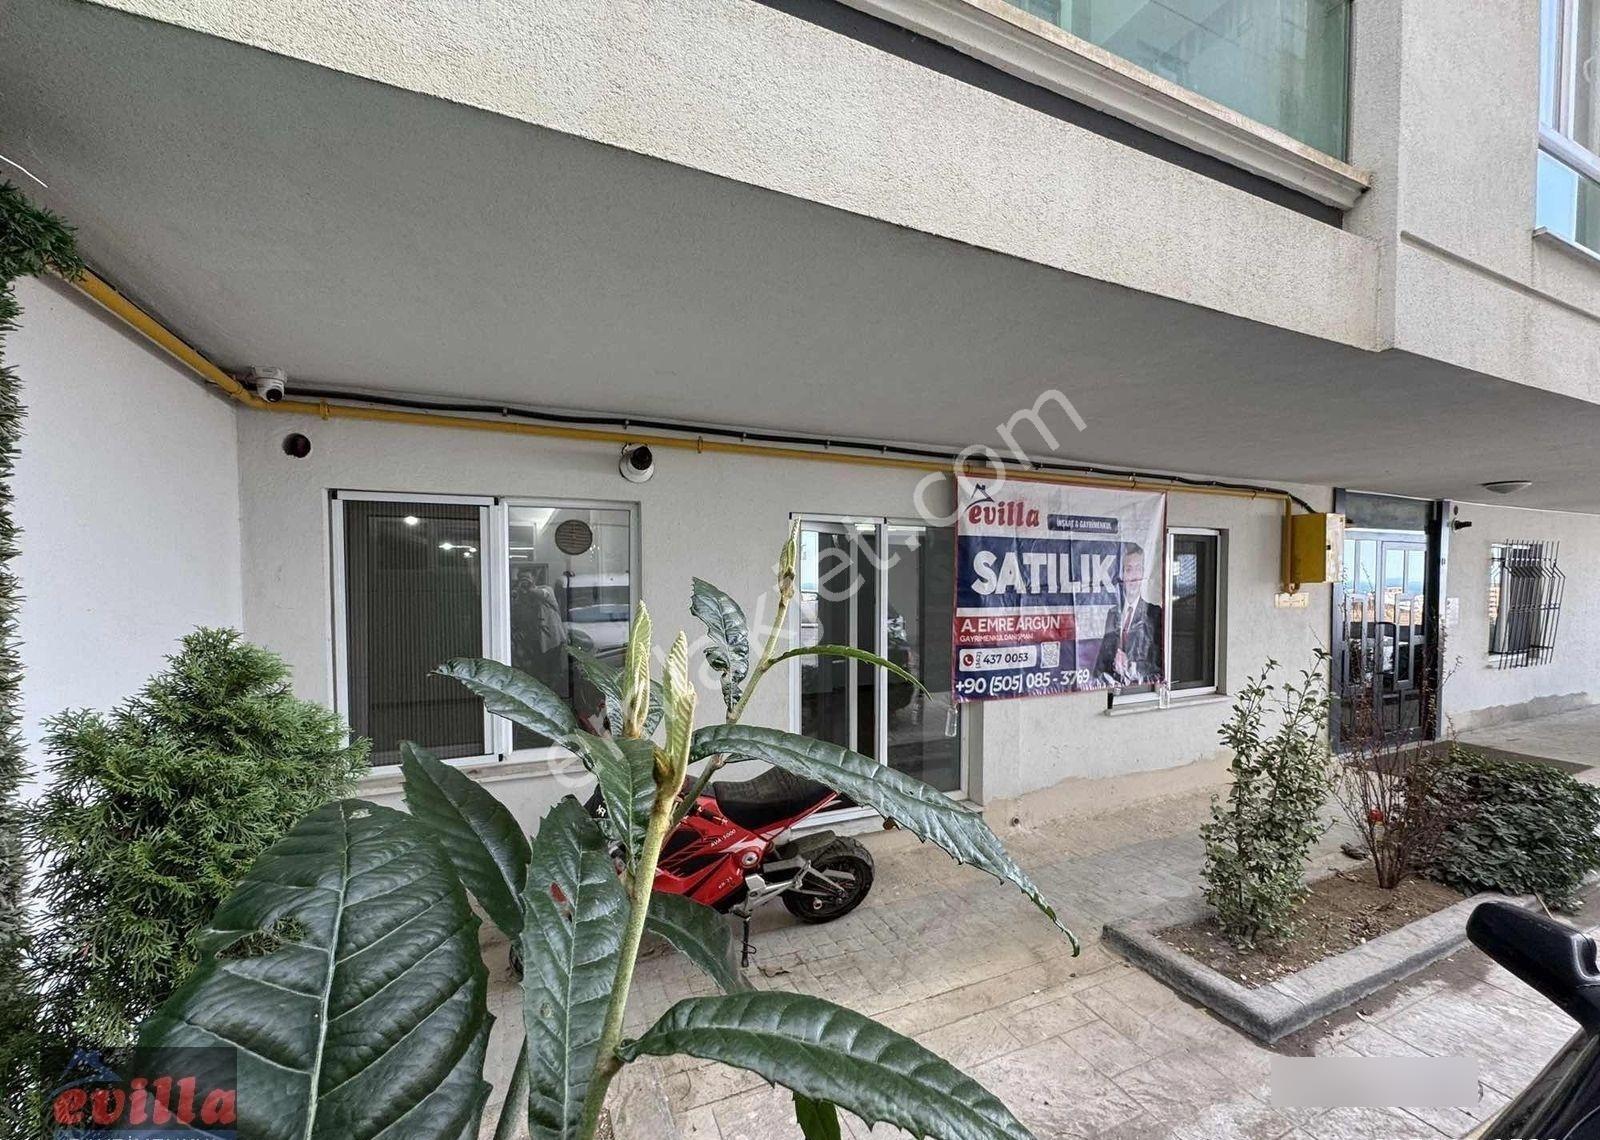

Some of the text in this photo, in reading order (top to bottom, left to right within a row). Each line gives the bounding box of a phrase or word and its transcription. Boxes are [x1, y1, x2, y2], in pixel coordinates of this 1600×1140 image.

[969, 501, 1039, 527] evilla
[971, 550, 1117, 595] SATILIK
[978, 617, 1014, 632] EMRE
[983, 653, 1002, 664] 437
[1004, 653, 1028, 663] 0053
[956, 677, 987, 694] +90
[1026, 672, 1051, 688] 085
